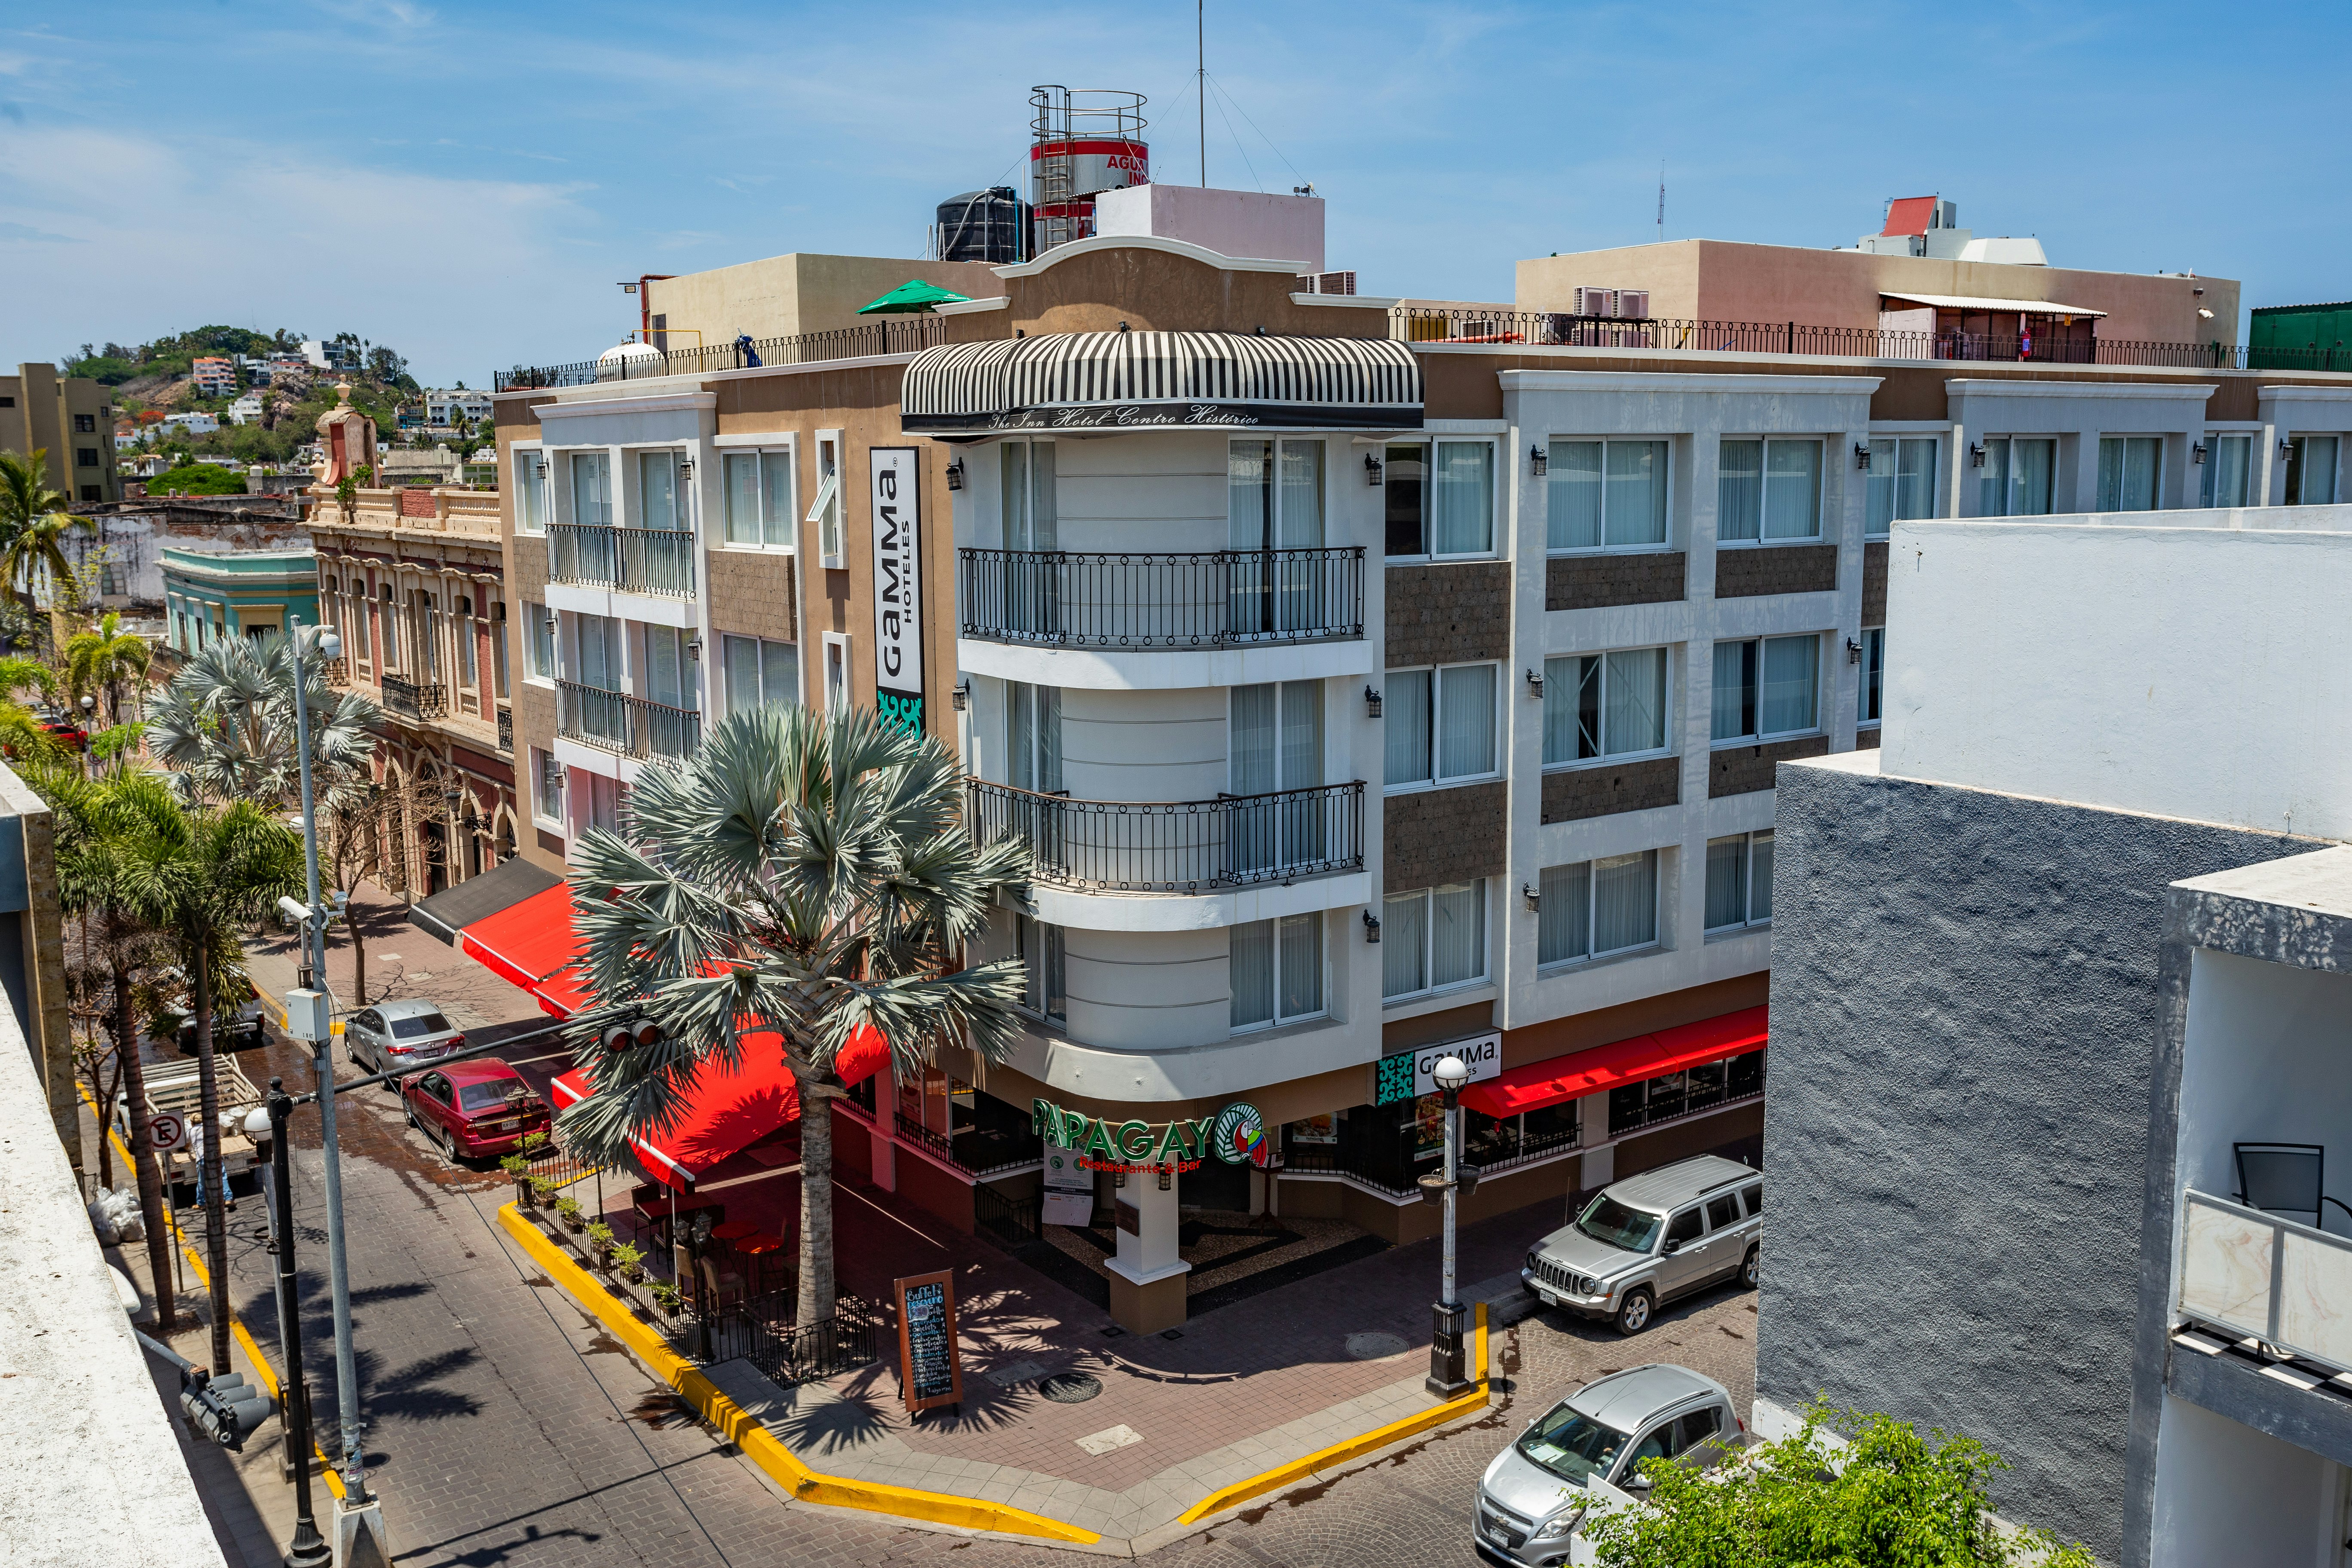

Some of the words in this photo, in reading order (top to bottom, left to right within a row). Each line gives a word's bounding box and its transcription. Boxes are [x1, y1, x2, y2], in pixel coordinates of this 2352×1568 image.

[1107, 155, 1144, 172] AGUA
[989, 413, 1009, 429] The
[1013, 410, 1045, 427] Inn
[1053, 408, 1111, 426] Hotel
[1115, 406, 1176, 425] Centro
[902, 521, 912, 623] HOTELES
[1079, 1156, 1160, 1174] Restaurante
[1165, 1162, 1175, 1173] &
[1178, 1160, 1201, 1173] Bar
